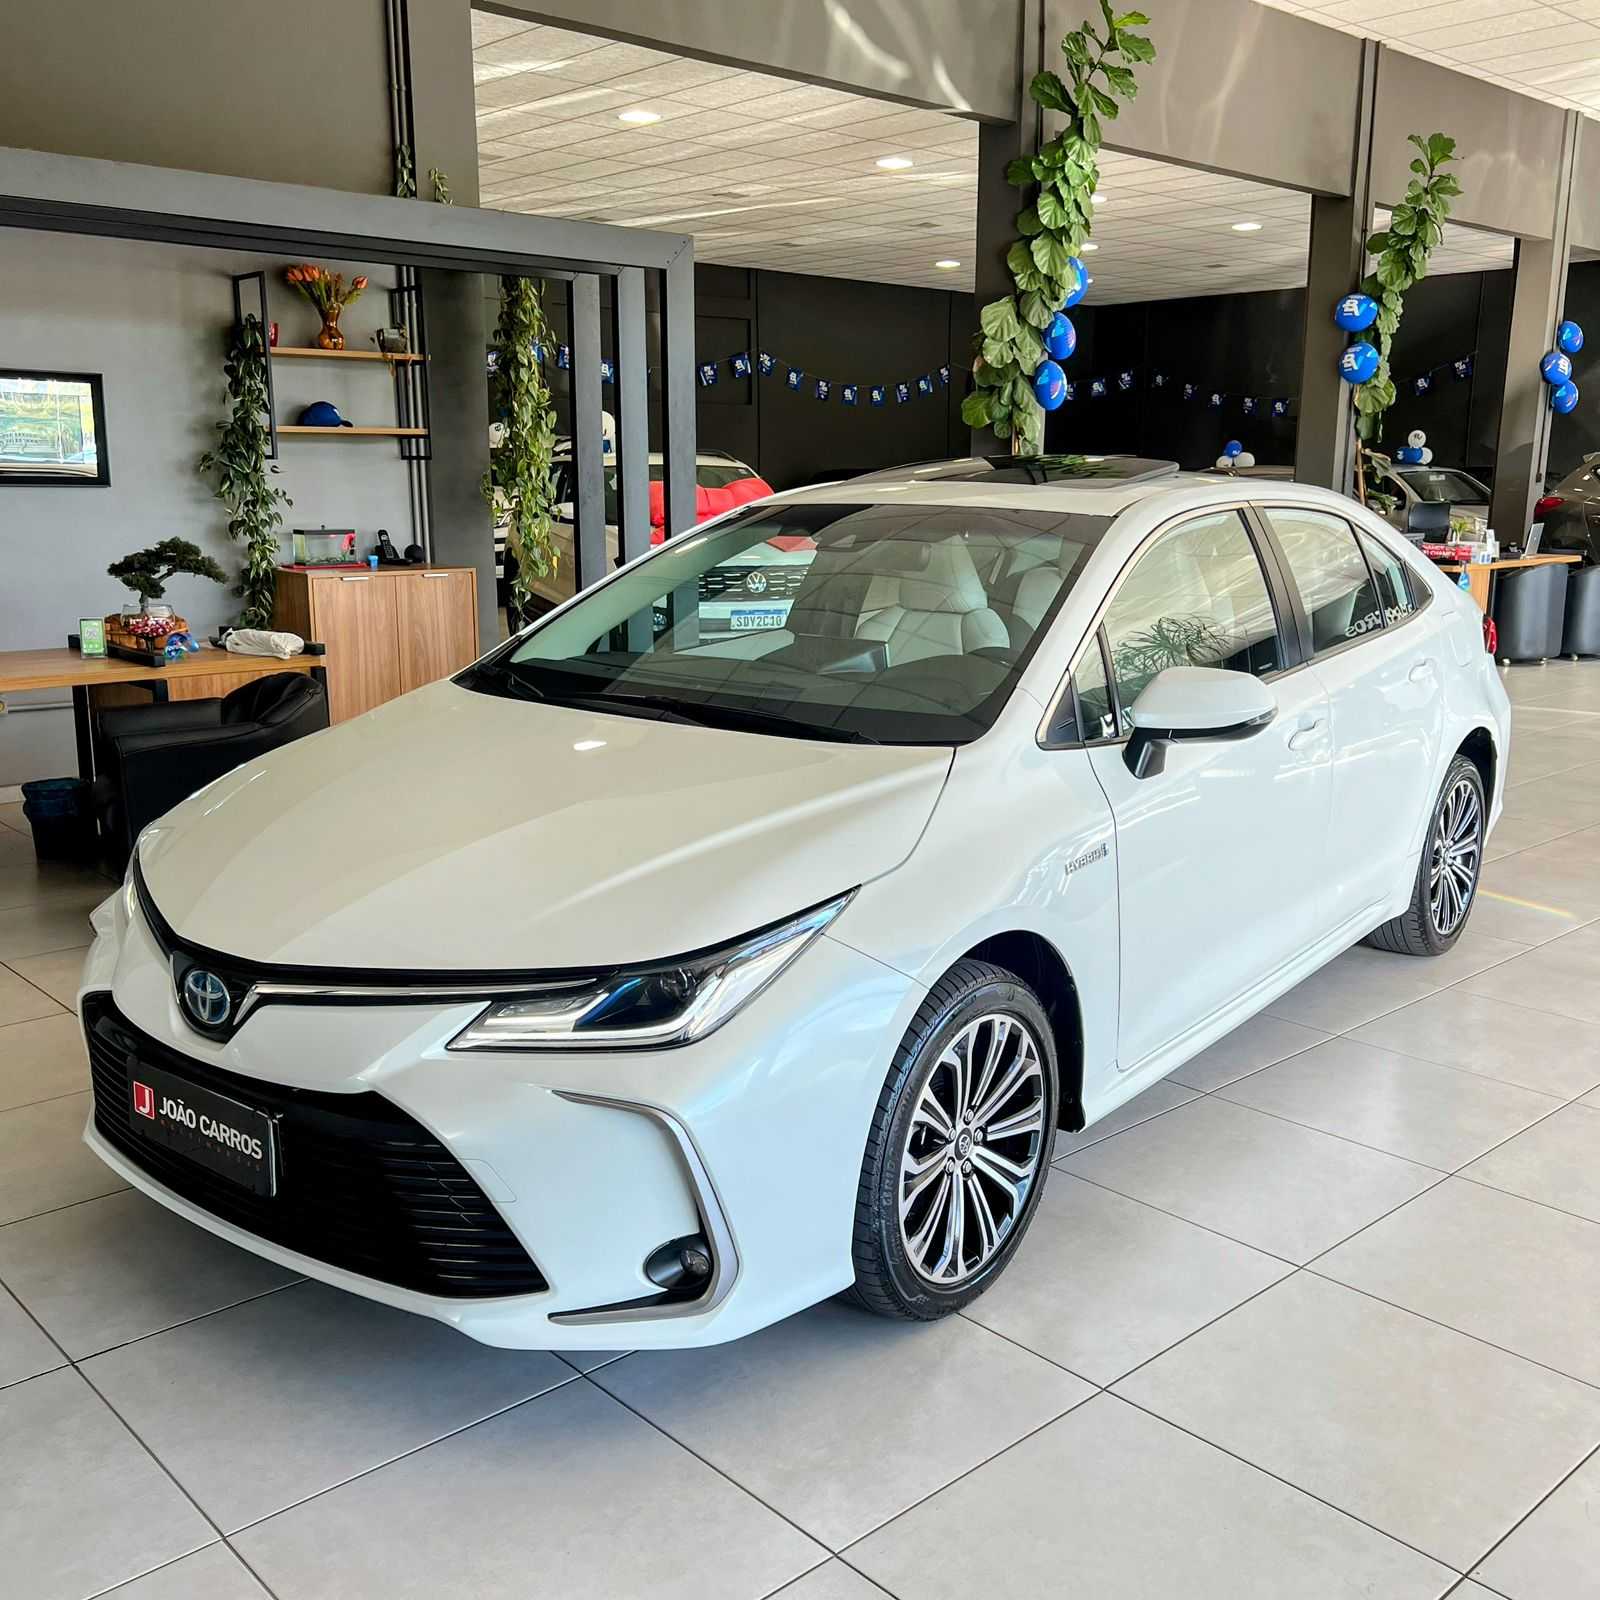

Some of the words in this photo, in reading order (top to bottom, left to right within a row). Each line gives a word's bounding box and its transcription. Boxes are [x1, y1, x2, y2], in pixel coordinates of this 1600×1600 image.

[736, 615, 782, 628] SDY2C10
[159, 1097, 197, 1129] JOÃO
[199, 1115, 263, 1160] CARROS
